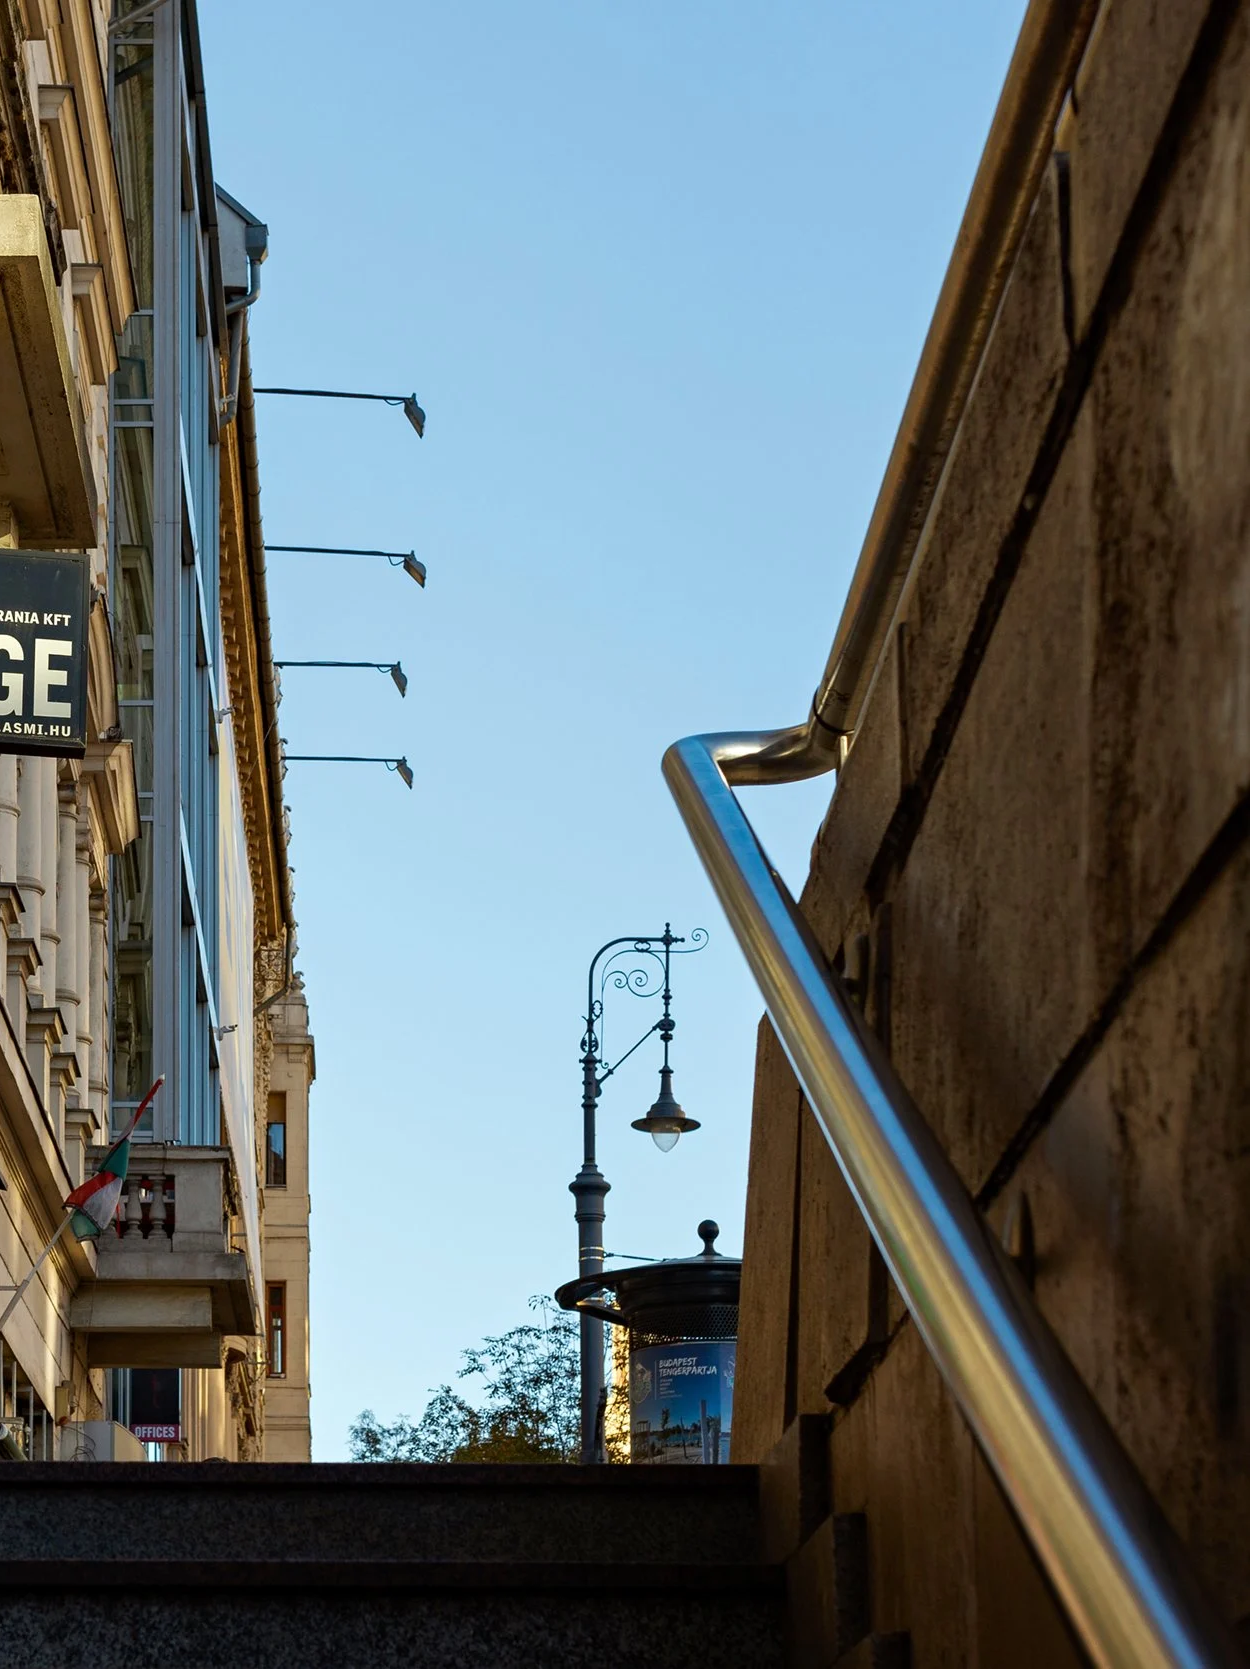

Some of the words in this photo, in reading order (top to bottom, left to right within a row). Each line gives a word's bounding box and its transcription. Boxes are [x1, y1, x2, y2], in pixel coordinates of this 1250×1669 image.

[43, 613, 71, 627] KFT
[659, 1357, 698, 1368] BUDAPEST
[659, 1366, 718, 1377] TENGERPARTJA
[135, 1426, 175, 1438] OFFICES
